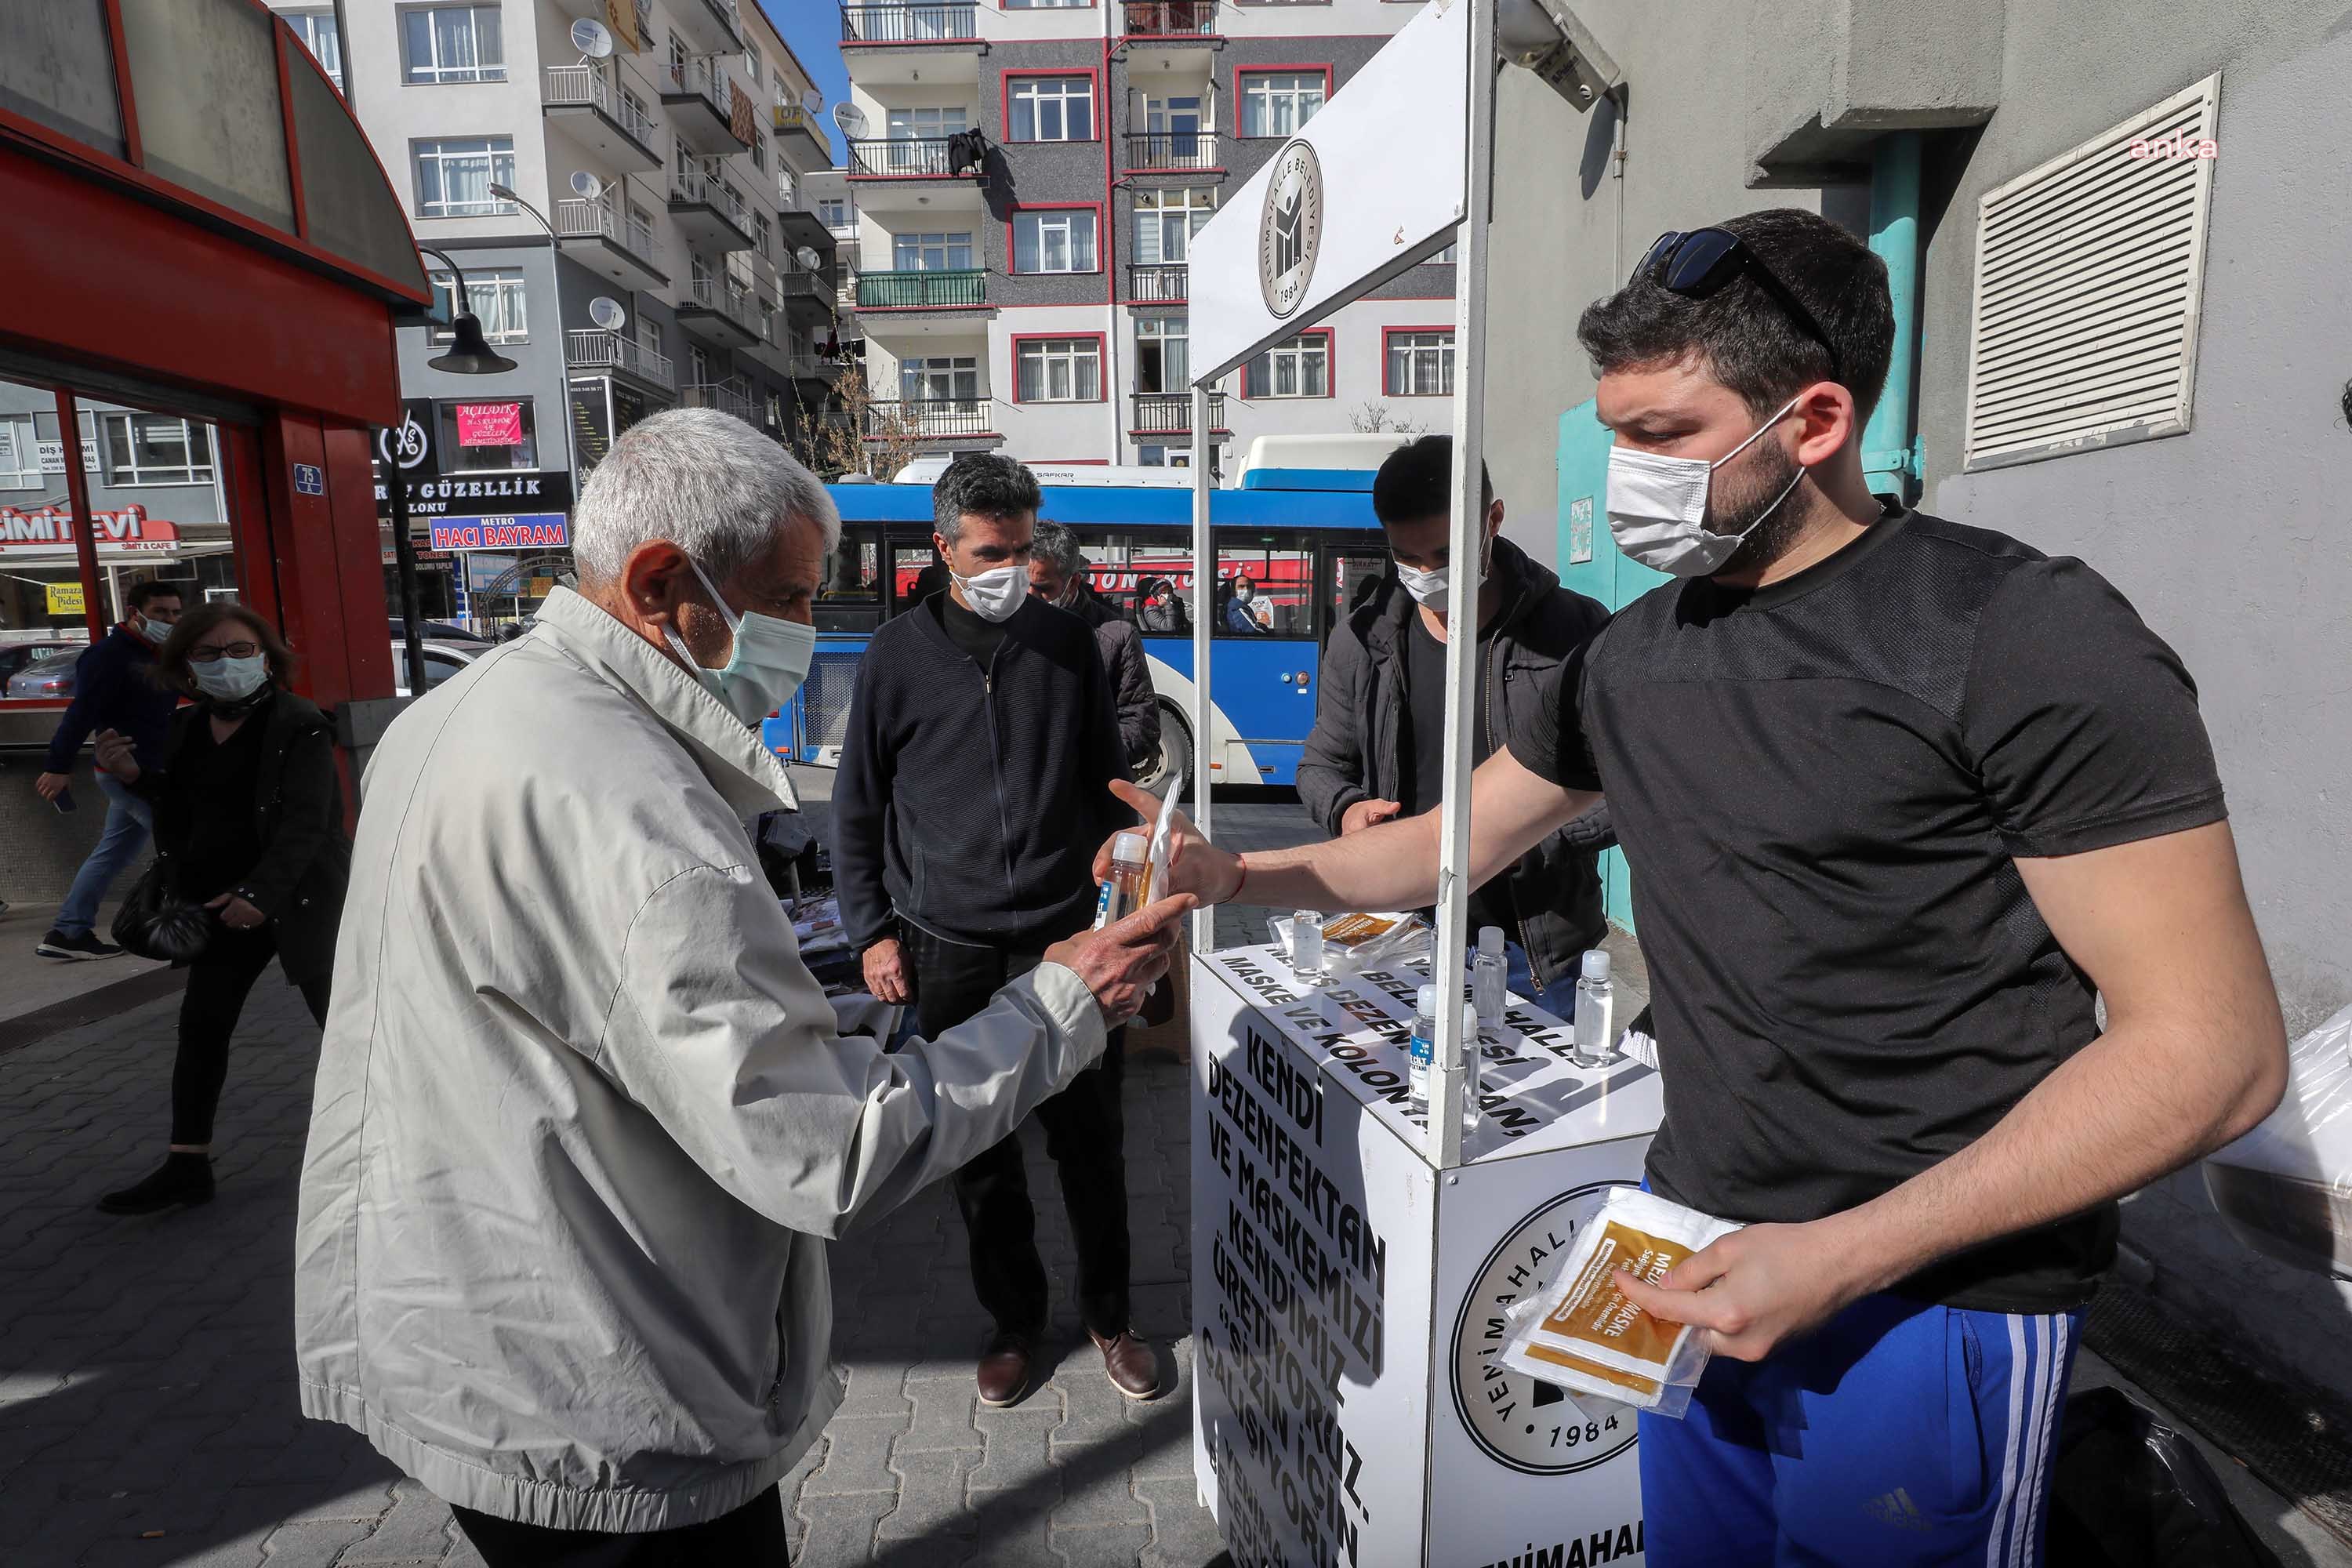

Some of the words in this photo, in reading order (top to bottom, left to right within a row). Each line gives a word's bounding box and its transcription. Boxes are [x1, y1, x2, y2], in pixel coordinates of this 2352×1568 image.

[1279, 279, 1298, 303] 1984
[39, 445, 56, 455] DİŞ
[302, 467, 314, 482] 75
[307, 484, 313, 492] A
[421, 477, 540, 499] GÜZELLİK
[481, 517, 515, 526] METRO
[412, 539, 431, 547] KAR
[434, 527, 481, 547] HACI
[483, 524, 564, 546] BAYRAM
[416, 551, 449, 560] TONER
[50, 586, 82, 597] Ramaza
[57, 596, 82, 608] Pidesi
[1220, 956, 1301, 1005] MASKE
[1284, 1007, 1333, 1030] VE
[1247, 1024, 1323, 1148] KENDİ
[1208, 1050, 1386, 1301] DEZENFEKTAN
[1208, 1109, 1231, 1180] VE
[1239, 1147, 1381, 1380] MASKEMİZİ
[1229, 1197, 1345, 1409] KENDİMİZ
[1604, 1301, 1642, 1337] MASKE
[1550, 1414, 1620, 1448] 1984
[1298, 1421, 1358, 1568] İÇİN
